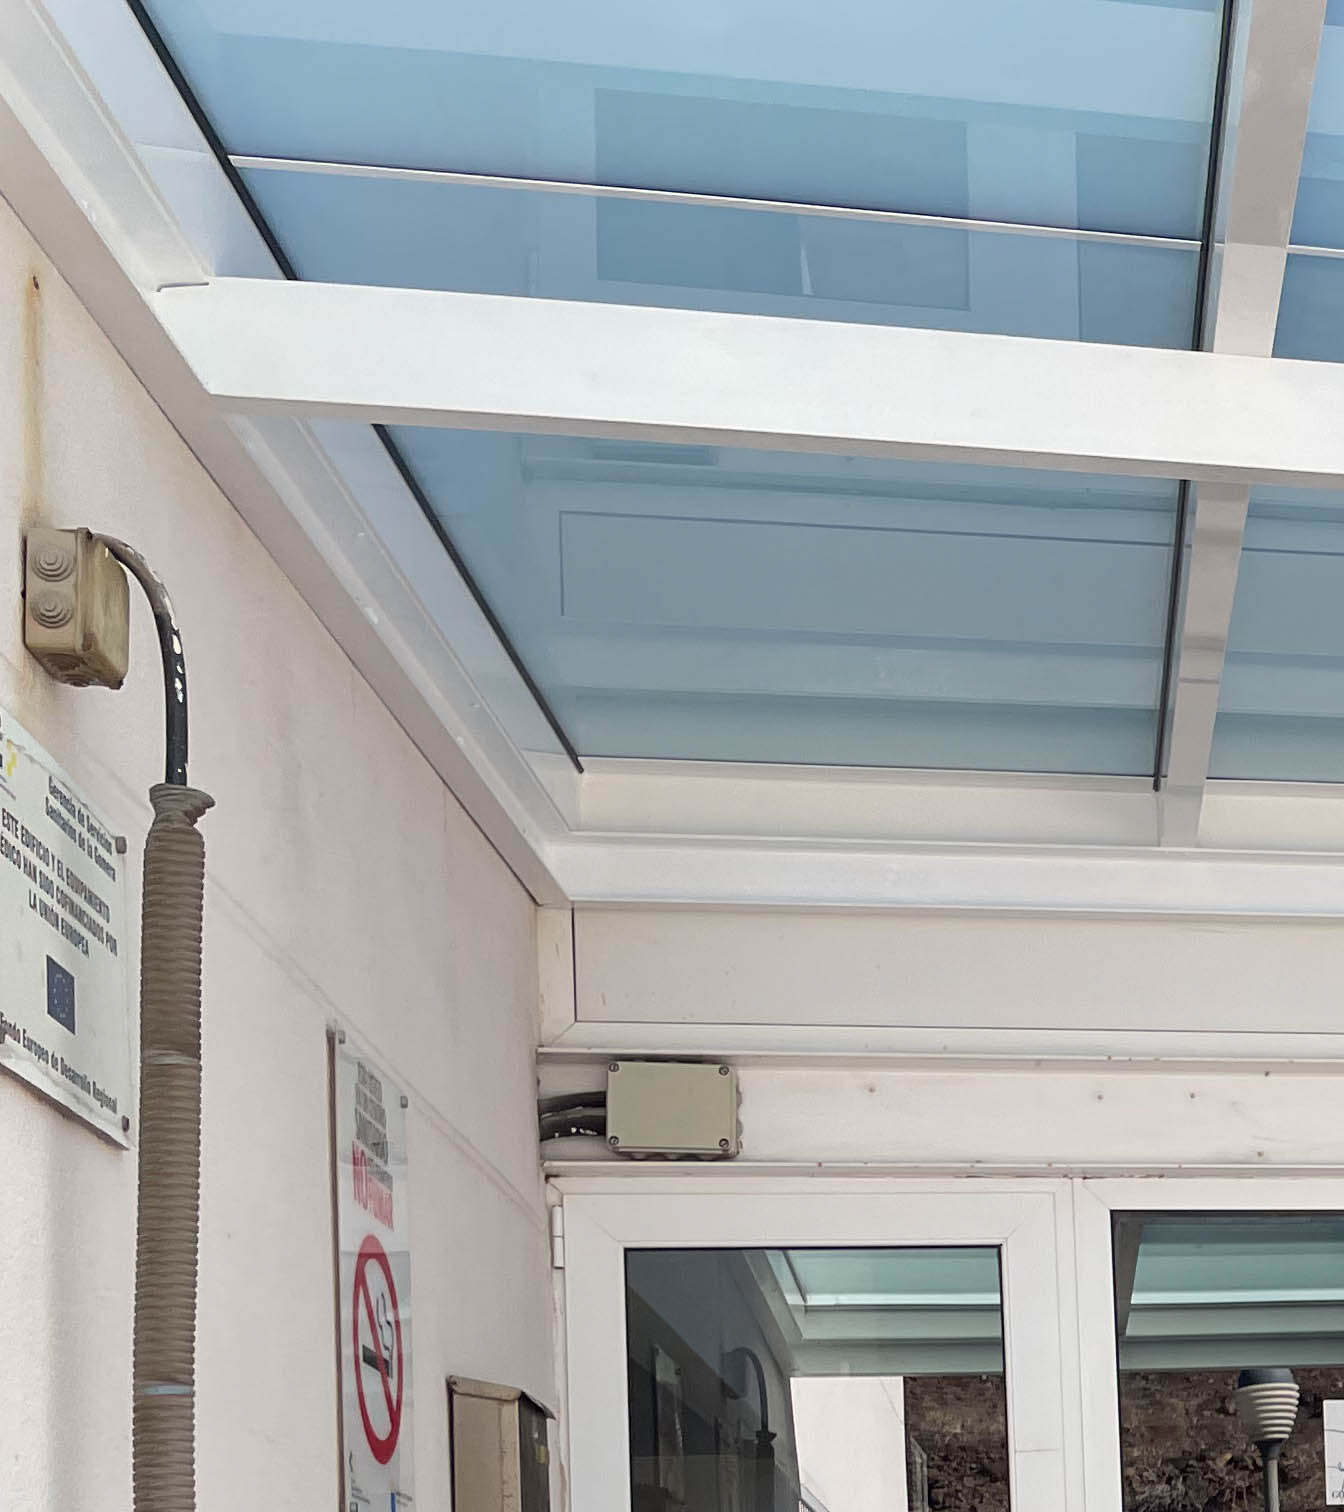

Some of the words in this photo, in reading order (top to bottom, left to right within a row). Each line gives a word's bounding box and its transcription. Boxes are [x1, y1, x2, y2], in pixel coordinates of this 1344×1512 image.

[2, 807, 19, 840] ESTE
[21, 824, 50, 867] EDIFICIO
[57, 858, 65, 882] EL
[66, 867, 110, 924] EQUIPAMIENTO
[78, 832, 86, 852] de
[87, 838, 92, 860] la
[0, 831, 21, 870] ÉDICO
[23, 855, 38, 884] HAN
[106, 931, 118, 956] POR
[28, 889, 38, 912] LA
[61, 917, 90, 958] EUROPEA
[22, 1028, 49, 1065] Europeo
[51, 1051, 58, 1072] de
